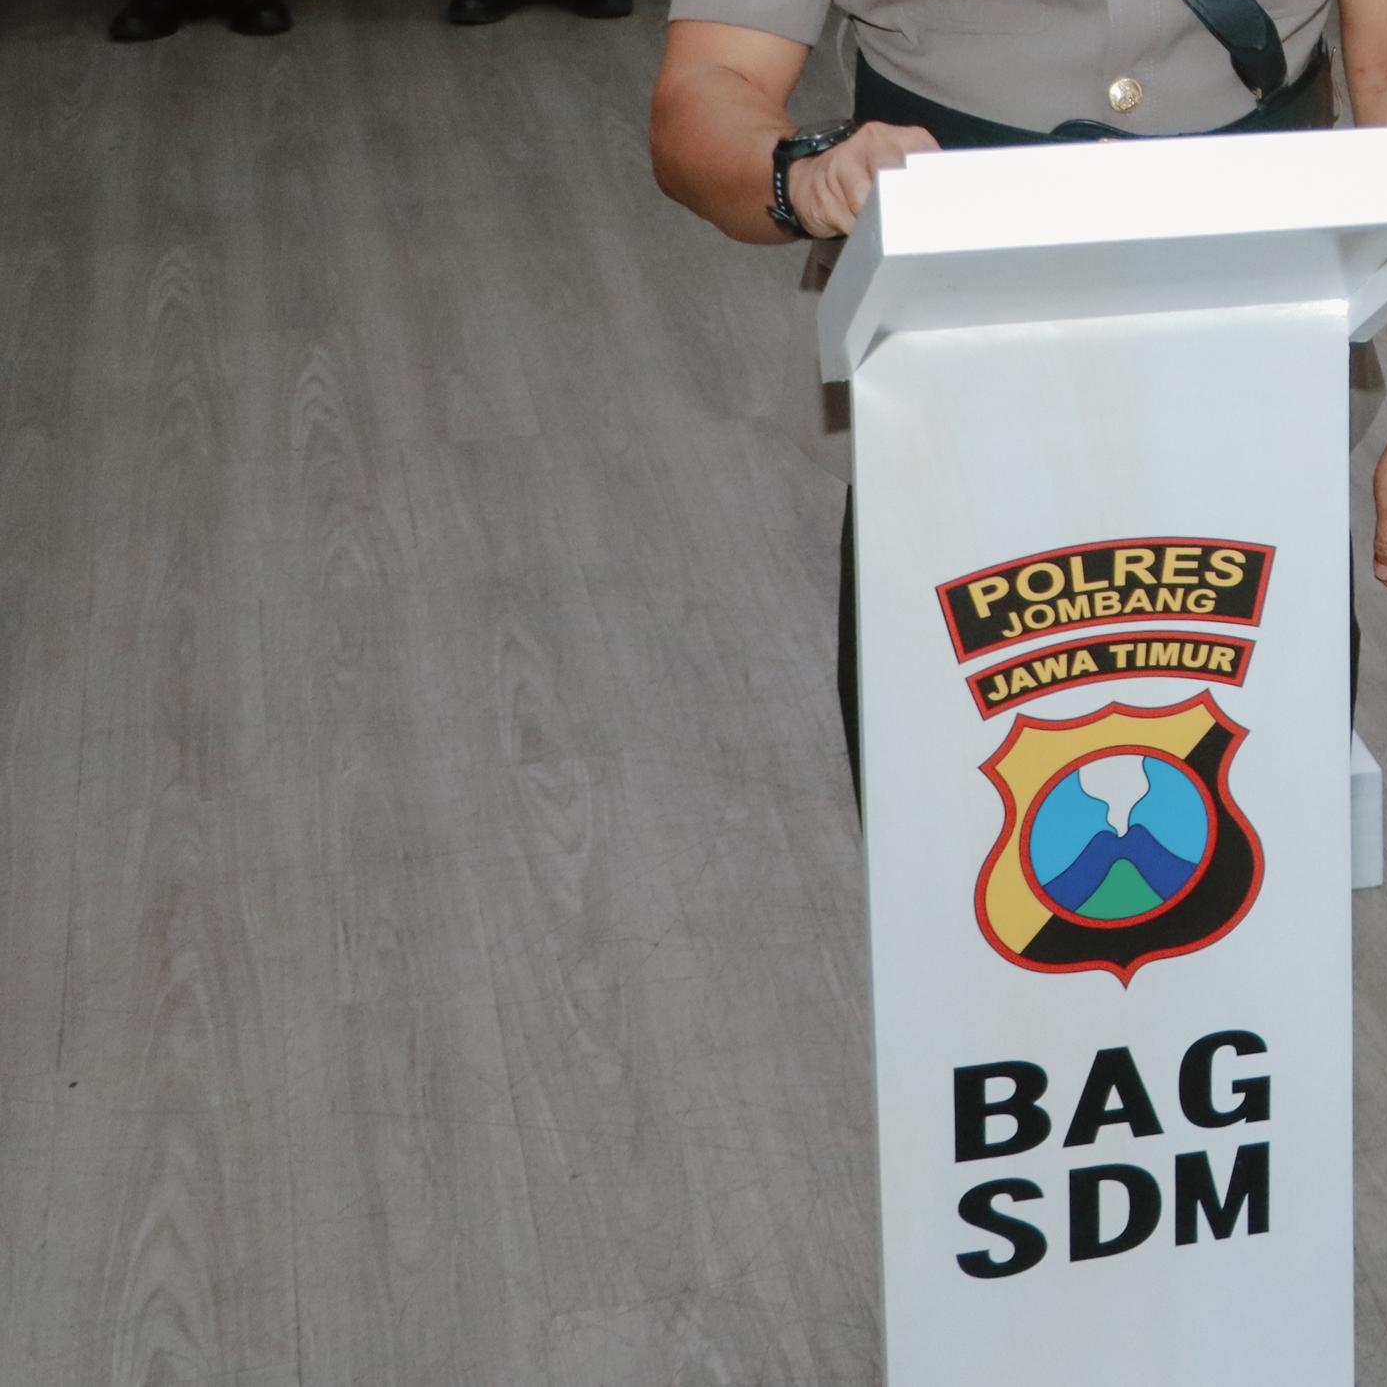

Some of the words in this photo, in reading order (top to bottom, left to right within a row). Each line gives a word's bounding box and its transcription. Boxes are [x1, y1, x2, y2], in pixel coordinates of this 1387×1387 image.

[967, 546, 1247, 619] POLRES
[1002, 587, 1218, 639] JOMBANG
[987, 649, 1100, 702] JAWA
[1109, 642, 1237, 673] TIMUR
[953, 1029, 1271, 1163] BAG
[955, 1140, 1270, 1280] SDM
